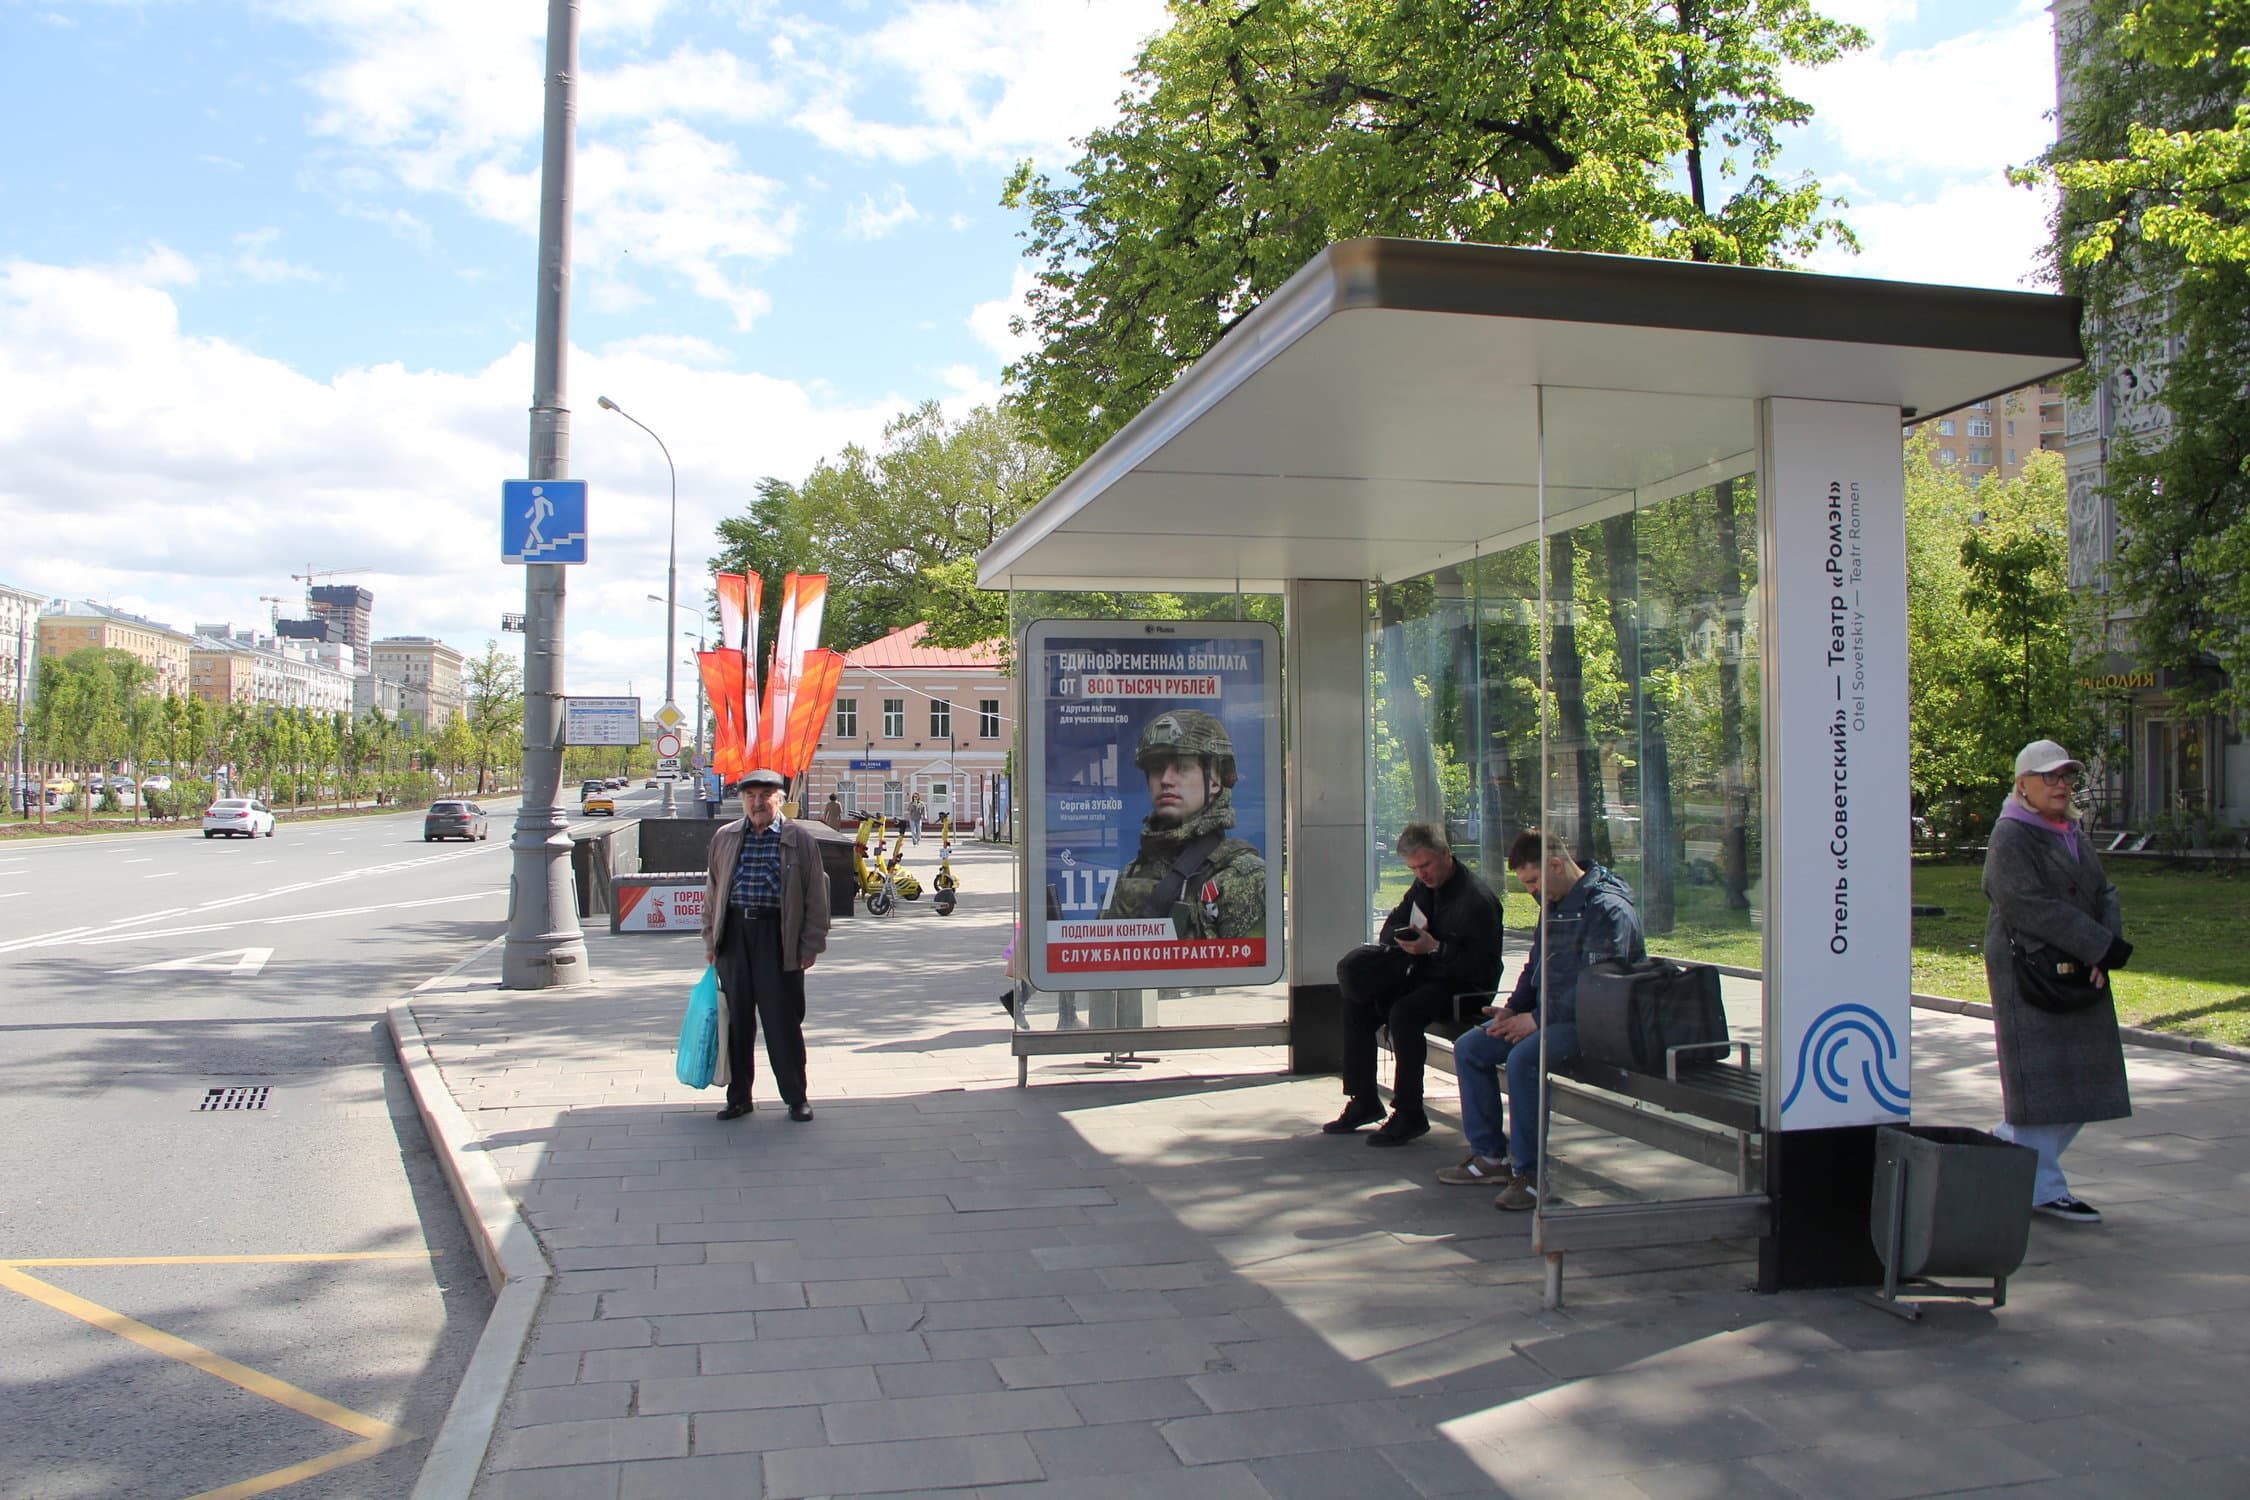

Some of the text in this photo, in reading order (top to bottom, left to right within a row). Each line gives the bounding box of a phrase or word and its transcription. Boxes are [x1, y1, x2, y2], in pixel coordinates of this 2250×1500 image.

[1849, 483, 1861, 539] Romen
[1825, 480, 1844, 588] «Ромэн»
[1849, 544, 1862, 584] Teatr
[1828, 595, 1848, 667] Театр
[1060, 653, 1248, 671] ЕДИНОВРЕМЕННАЯ ВЫПЛАТА
[1851, 611, 1865, 690] Sovetskiy
[1060, 676, 1215, 694] ОТ 800 ТЫСЯЧ РУБЛЕЙ
[1066, 705, 1090, 714] другие
[1090, 705, 1117, 713] льготы
[1115, 715, 1129, 724] СВО
[1852, 697, 1864, 732] Otel
[1060, 799, 1123, 813] Сергей ЗУБКОВ
[1829, 708, 1848, 871] «Советский»
[1061, 870, 1118, 911] 117
[1061, 923, 1165, 939] ПОДПИШИ КОНТРАКТ
[1829, 877, 1848, 955] Отель
[1061, 944, 1252, 963] СЛУЖБАПОКОНТРАКТУ.РФ
